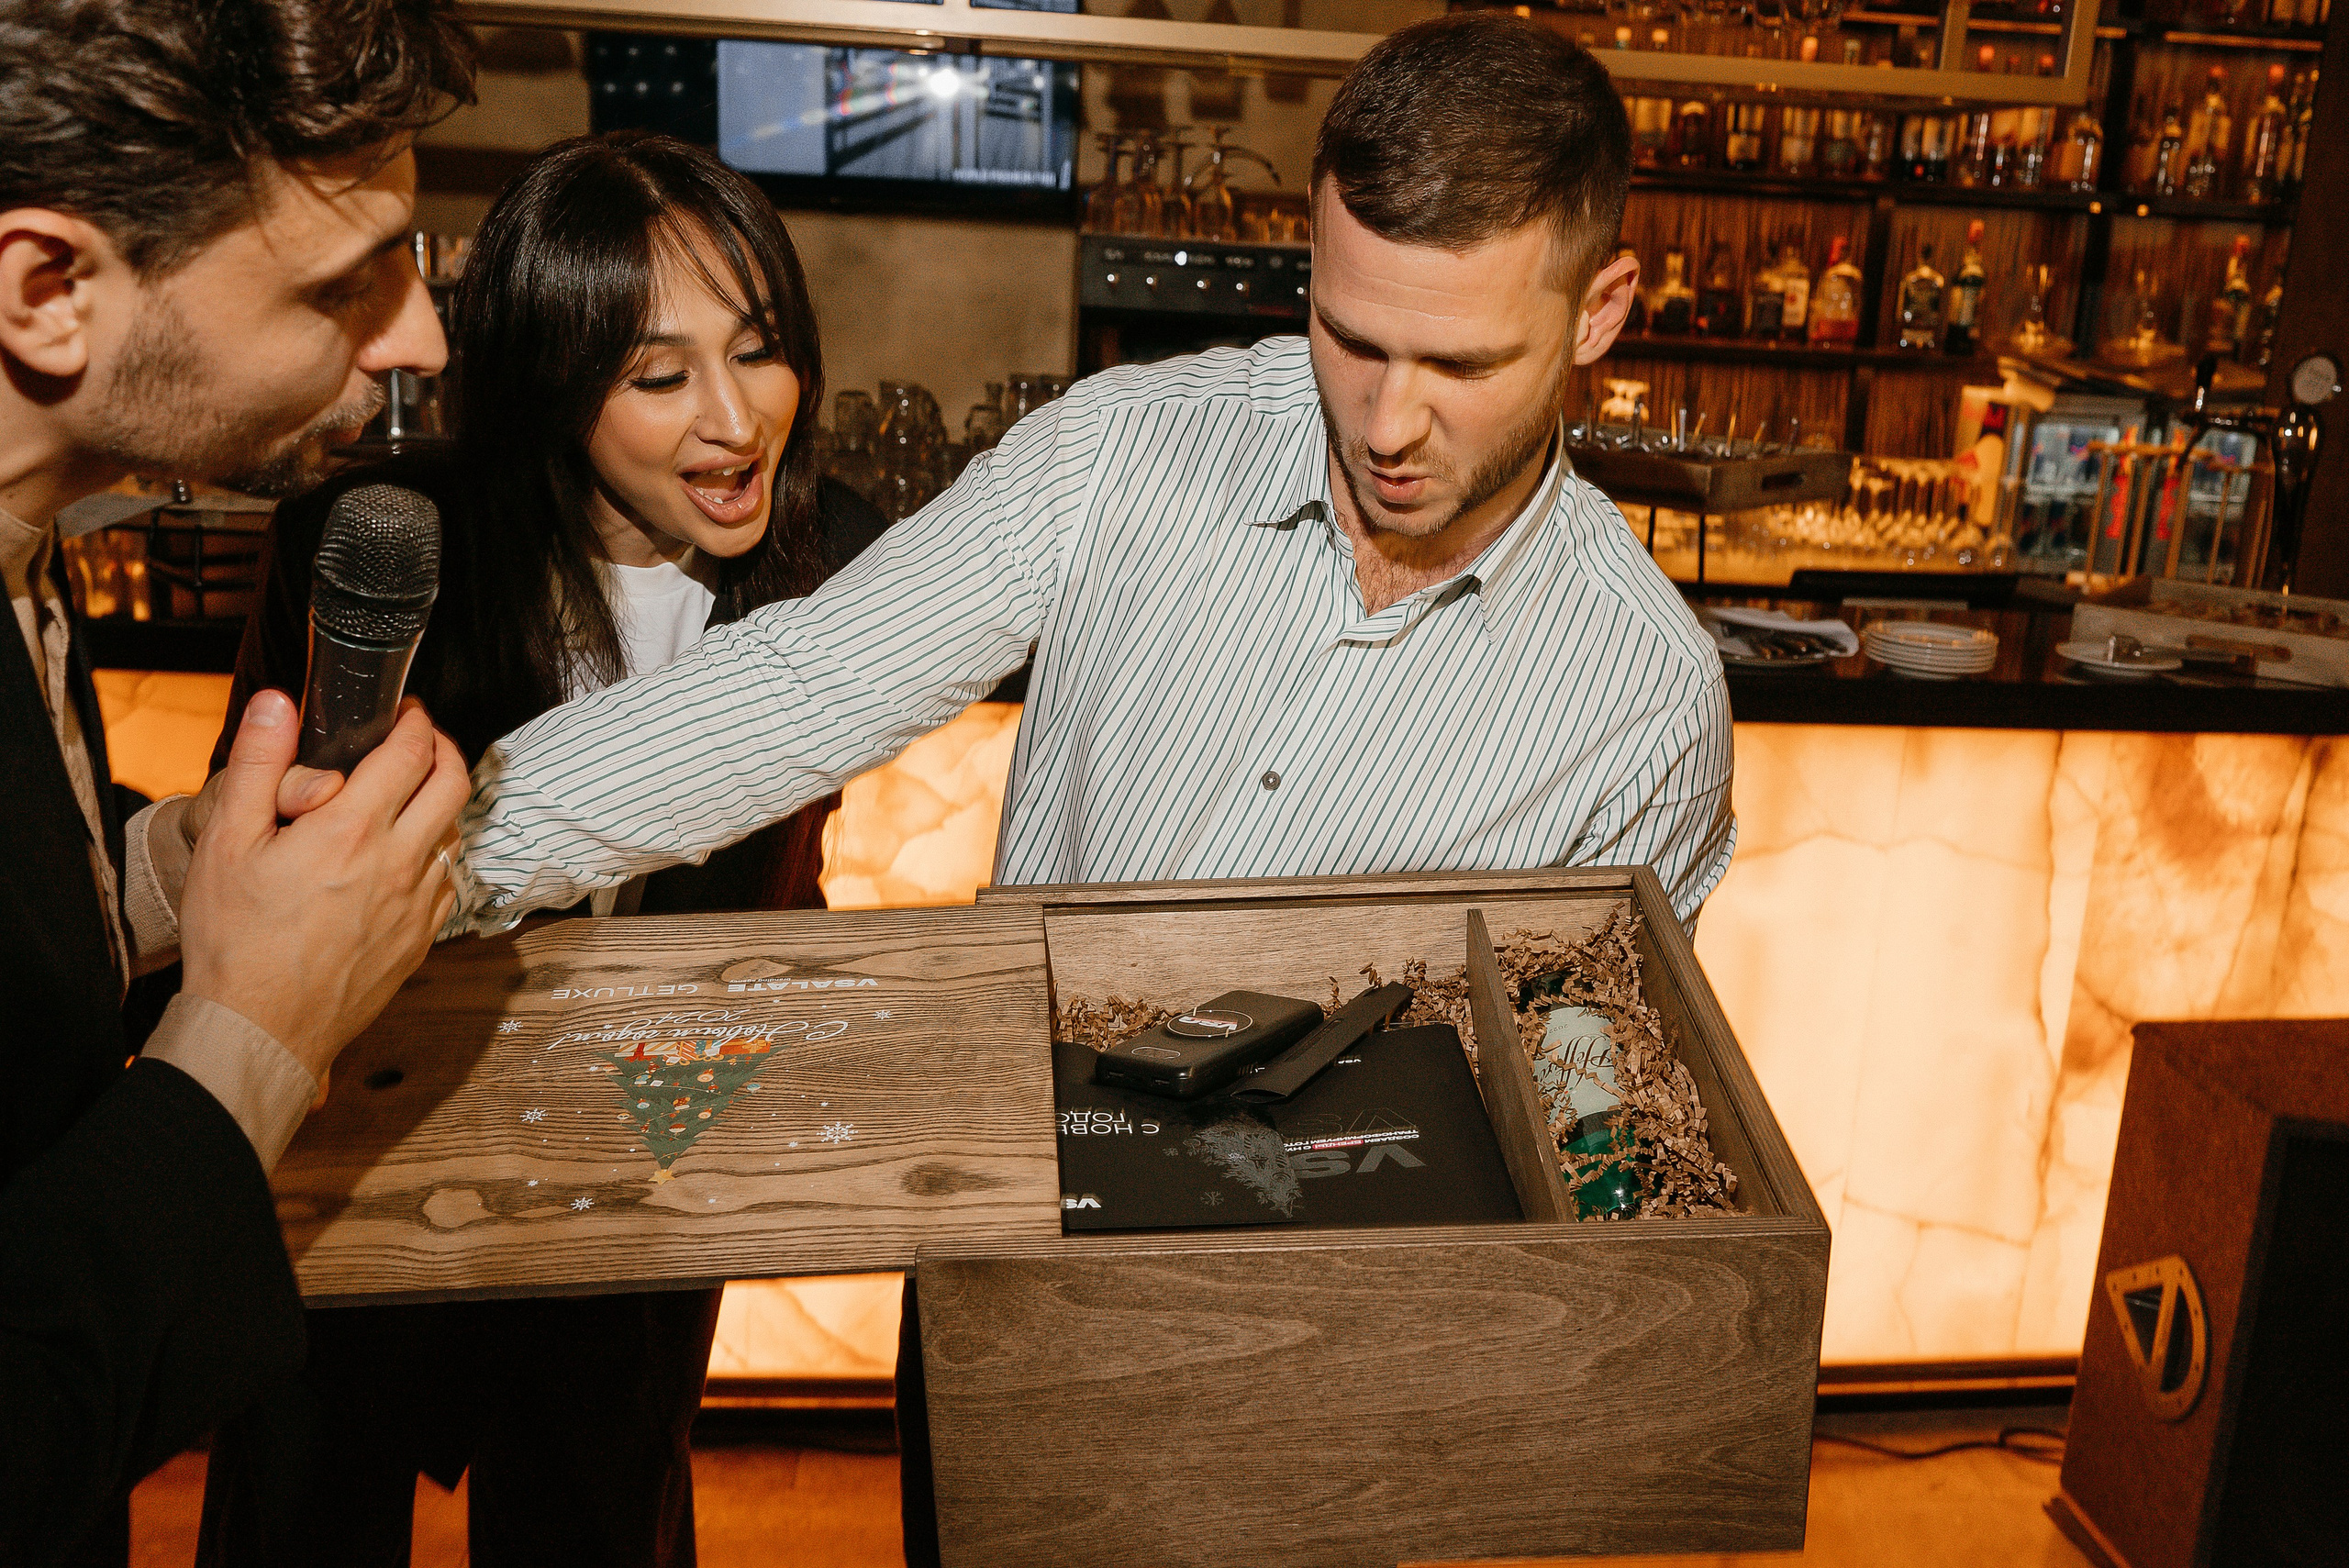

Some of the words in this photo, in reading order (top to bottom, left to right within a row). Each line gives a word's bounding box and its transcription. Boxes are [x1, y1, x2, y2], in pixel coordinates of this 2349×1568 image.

[551, 984, 699, 999] GETLUXE
[726, 978, 879, 993] VSALATE
[654, 1008, 751, 1025] 2024
[663, 1021, 809, 1049] Новым
[1314, 1140, 1363, 1149] БРЕНДЫ
[1364, 1134, 1420, 1144] СОЗДАЕМ
